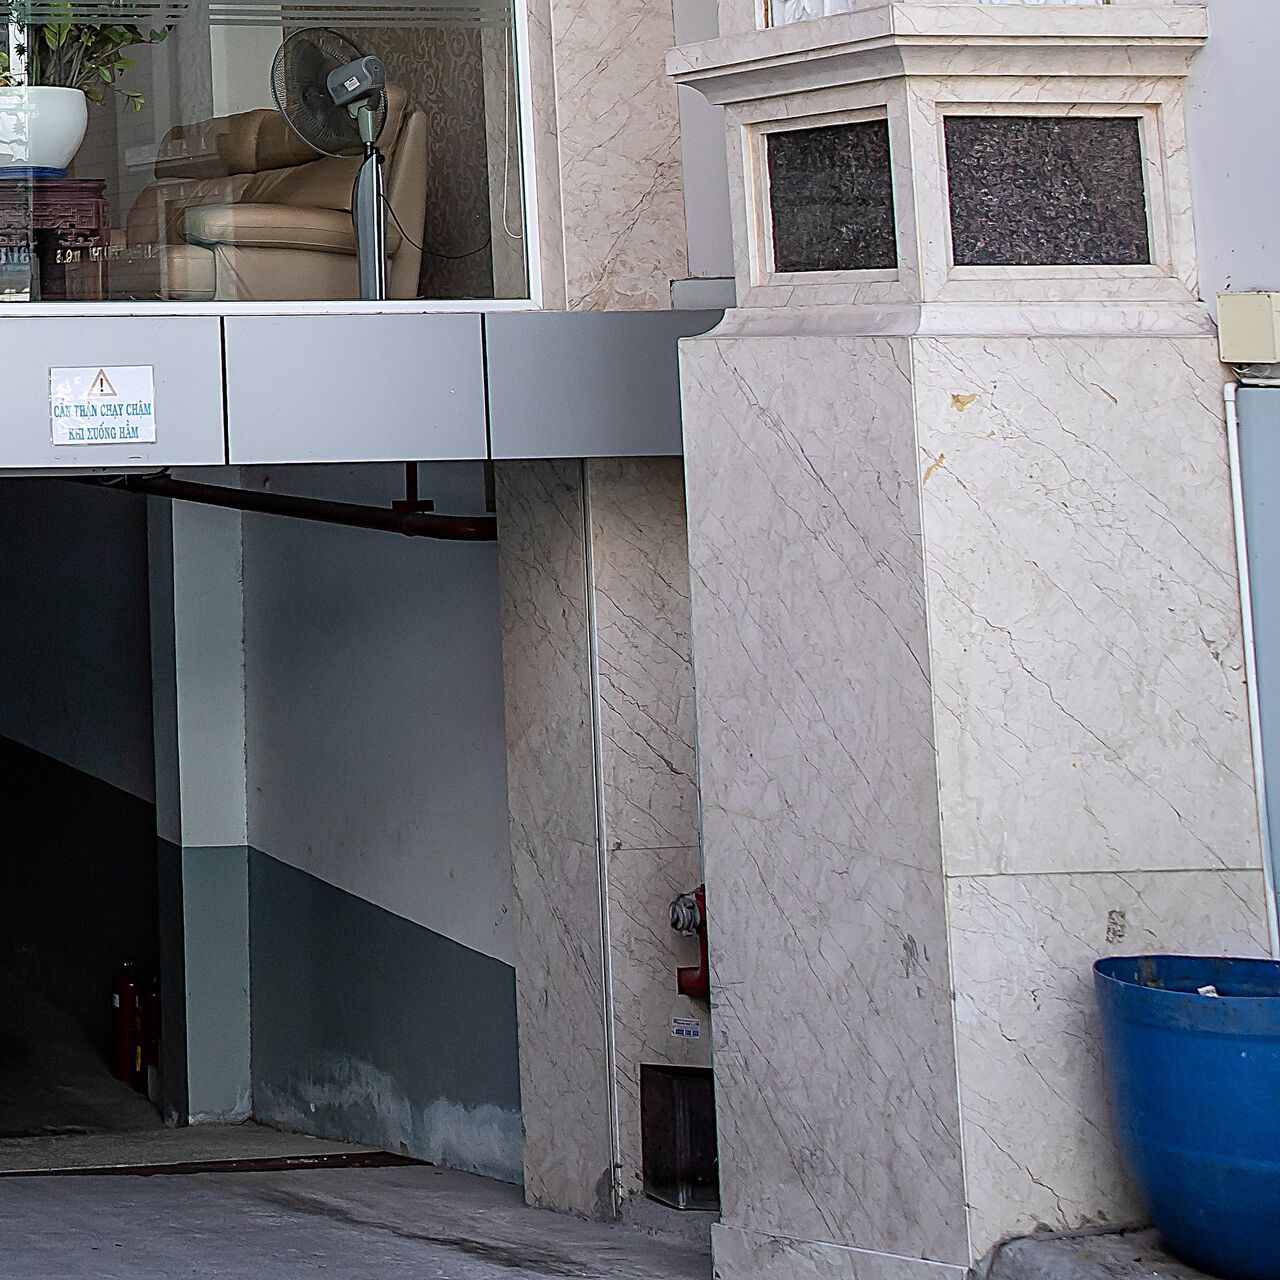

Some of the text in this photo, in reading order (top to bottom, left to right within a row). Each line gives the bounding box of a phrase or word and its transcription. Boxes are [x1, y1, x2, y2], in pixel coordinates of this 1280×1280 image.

[100, 403, 124, 420] CHẠY
[68, 419, 139, 441] KHI XUỐNG HẦM
